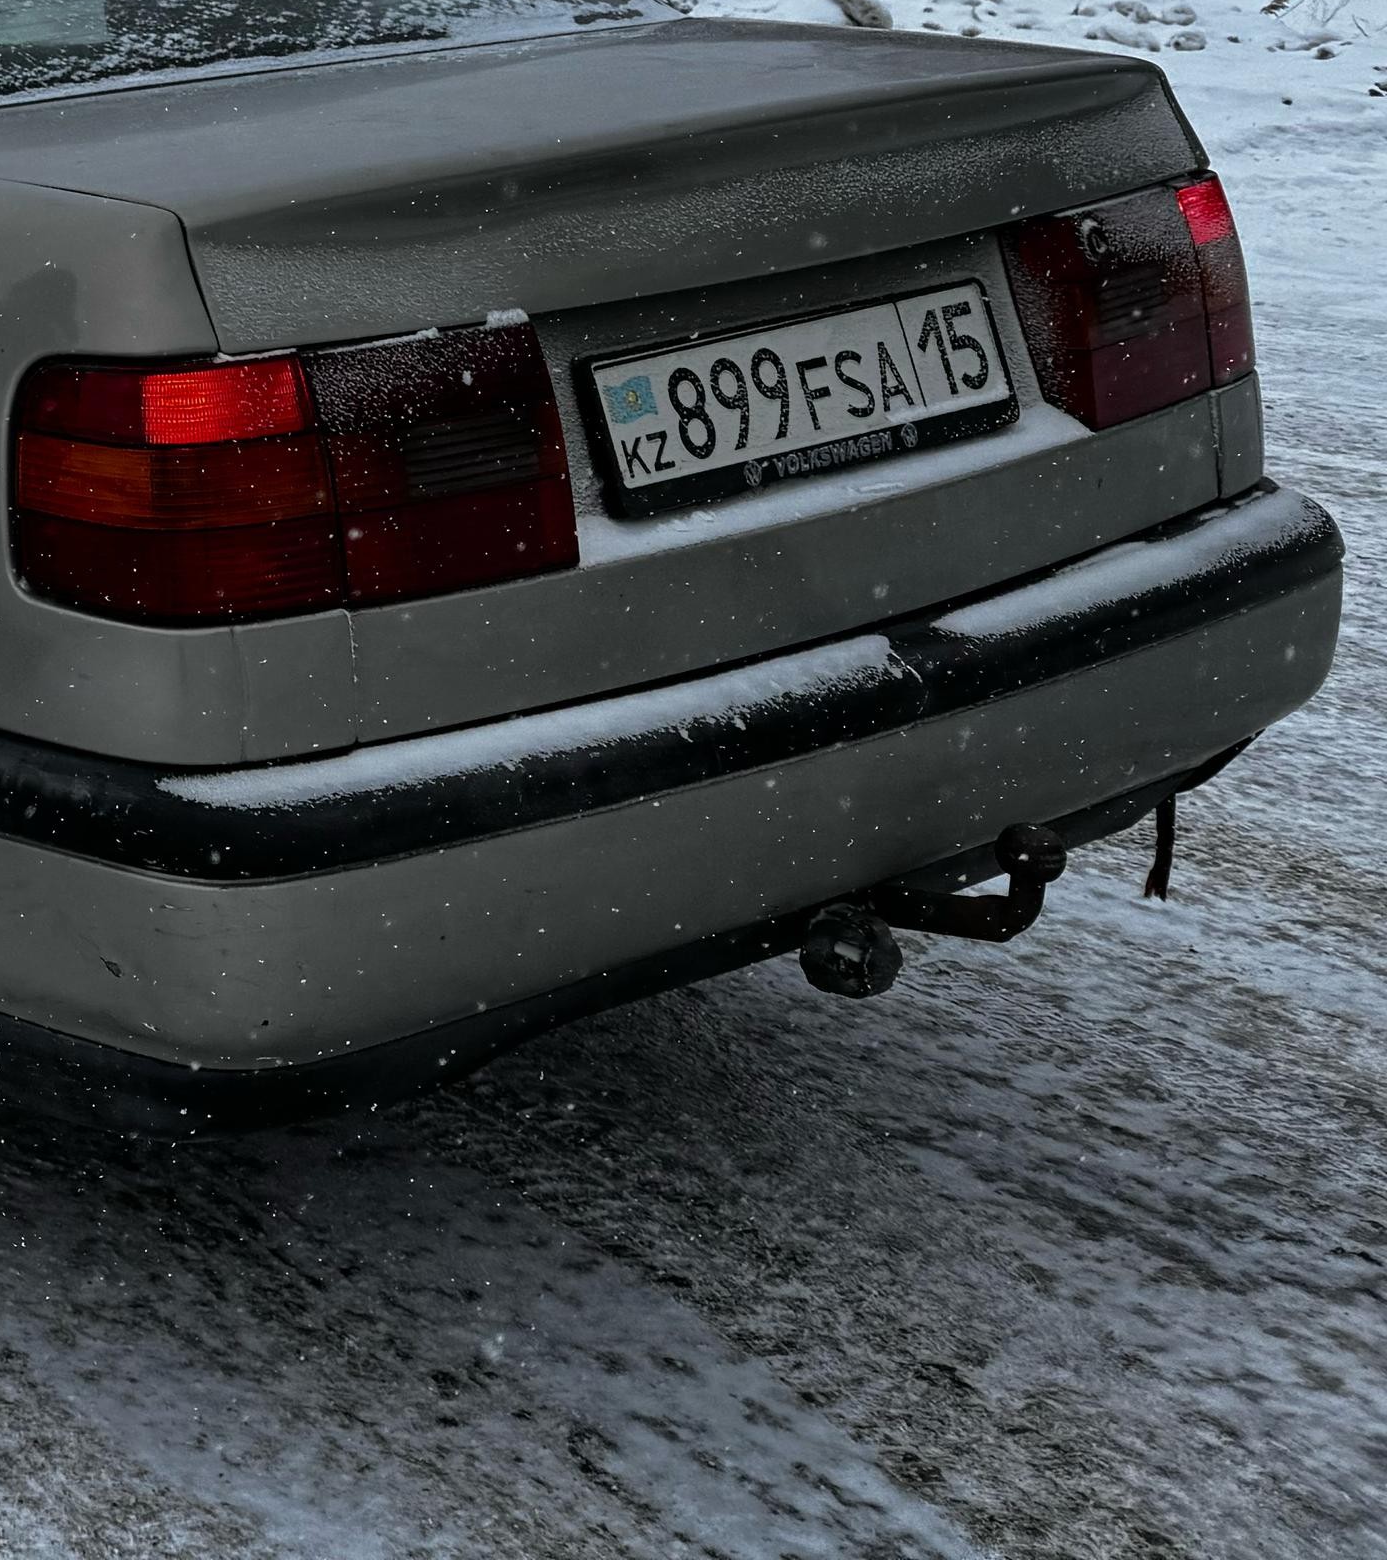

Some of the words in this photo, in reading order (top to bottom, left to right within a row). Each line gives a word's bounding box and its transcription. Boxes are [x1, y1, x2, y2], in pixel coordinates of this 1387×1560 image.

[667, 342, 915, 459] 899FSA
[917, 302, 990, 395] 15
[621, 431, 676, 479] KZ
[774, 431, 893, 477] VOLKSWAGEN
